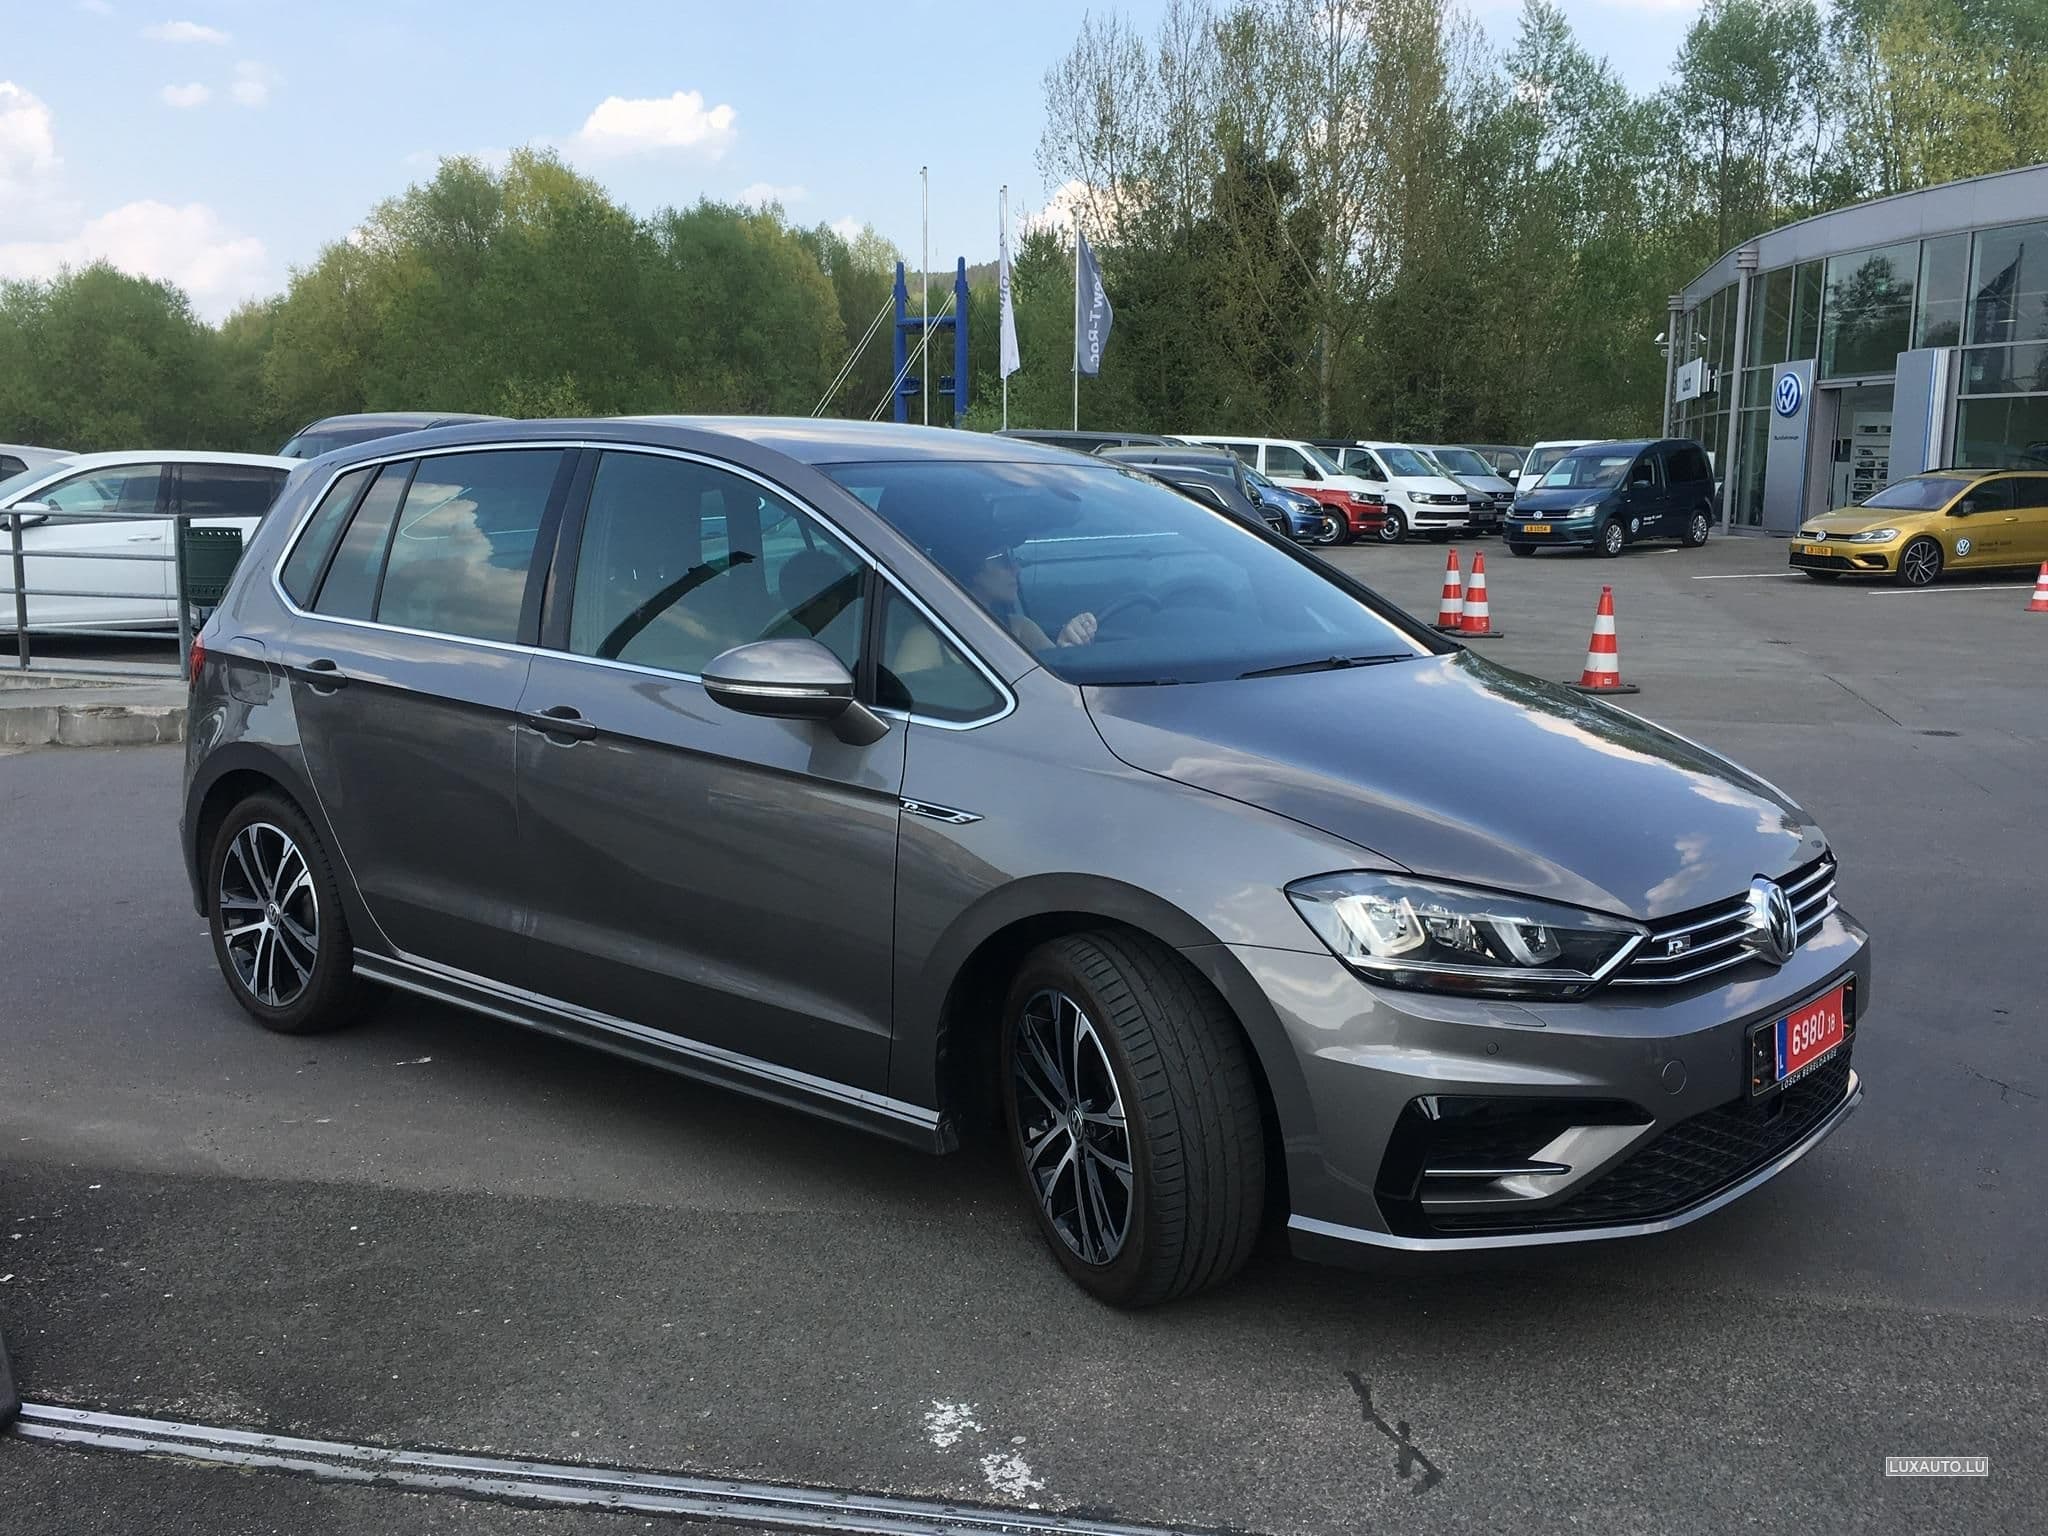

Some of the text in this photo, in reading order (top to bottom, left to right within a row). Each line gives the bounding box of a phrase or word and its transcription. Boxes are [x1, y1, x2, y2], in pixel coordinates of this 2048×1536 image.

[1775, 373, 1801, 416] VW
[1792, 1009, 1825, 1056] 6980
[1780, 1072, 1801, 1091] LOSCH
